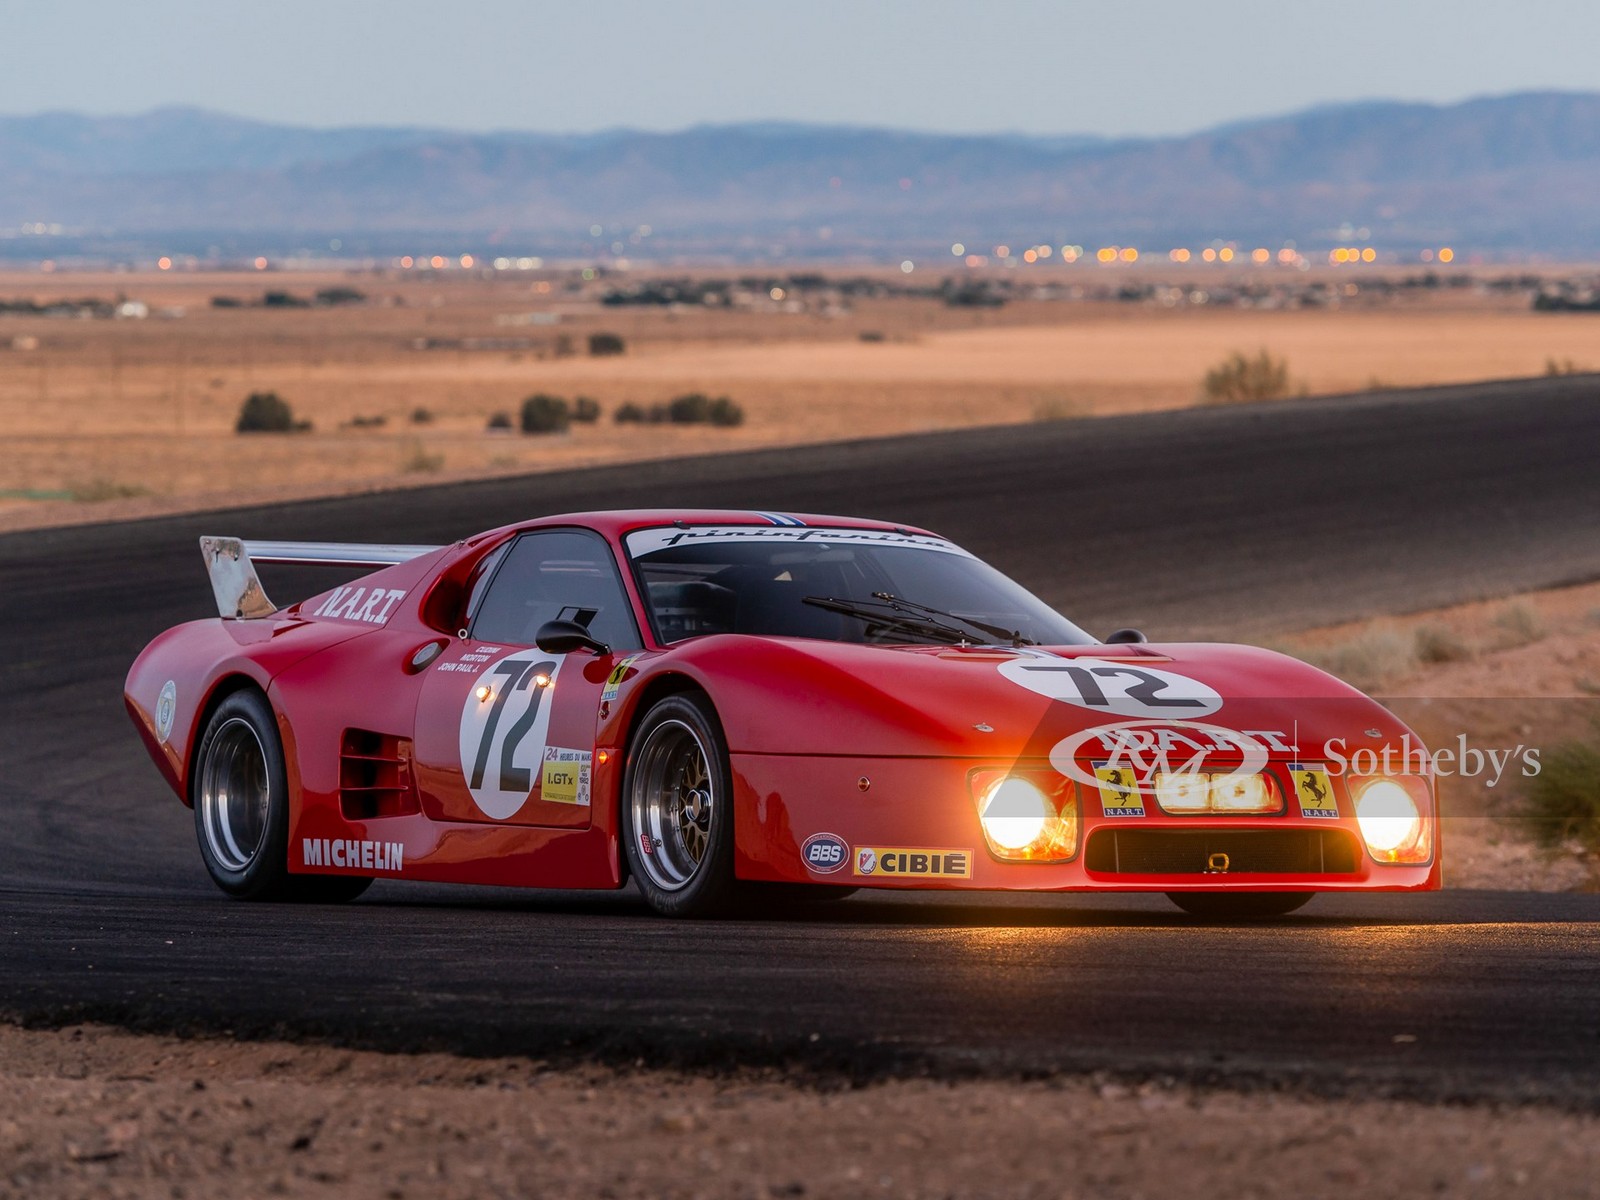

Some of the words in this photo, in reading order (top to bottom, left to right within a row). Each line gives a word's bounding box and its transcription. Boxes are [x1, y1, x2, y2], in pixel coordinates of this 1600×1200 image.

[661, 528, 953, 549] pininfarina
[1019, 665, 1208, 708] 72
[470, 660, 557, 792] 72
[545, 747, 558, 761] 24
[1105, 808, 1144, 816] N.A.R.T.
[303, 838, 404, 872] MICHELIN
[809, 844, 842, 862] BBS
